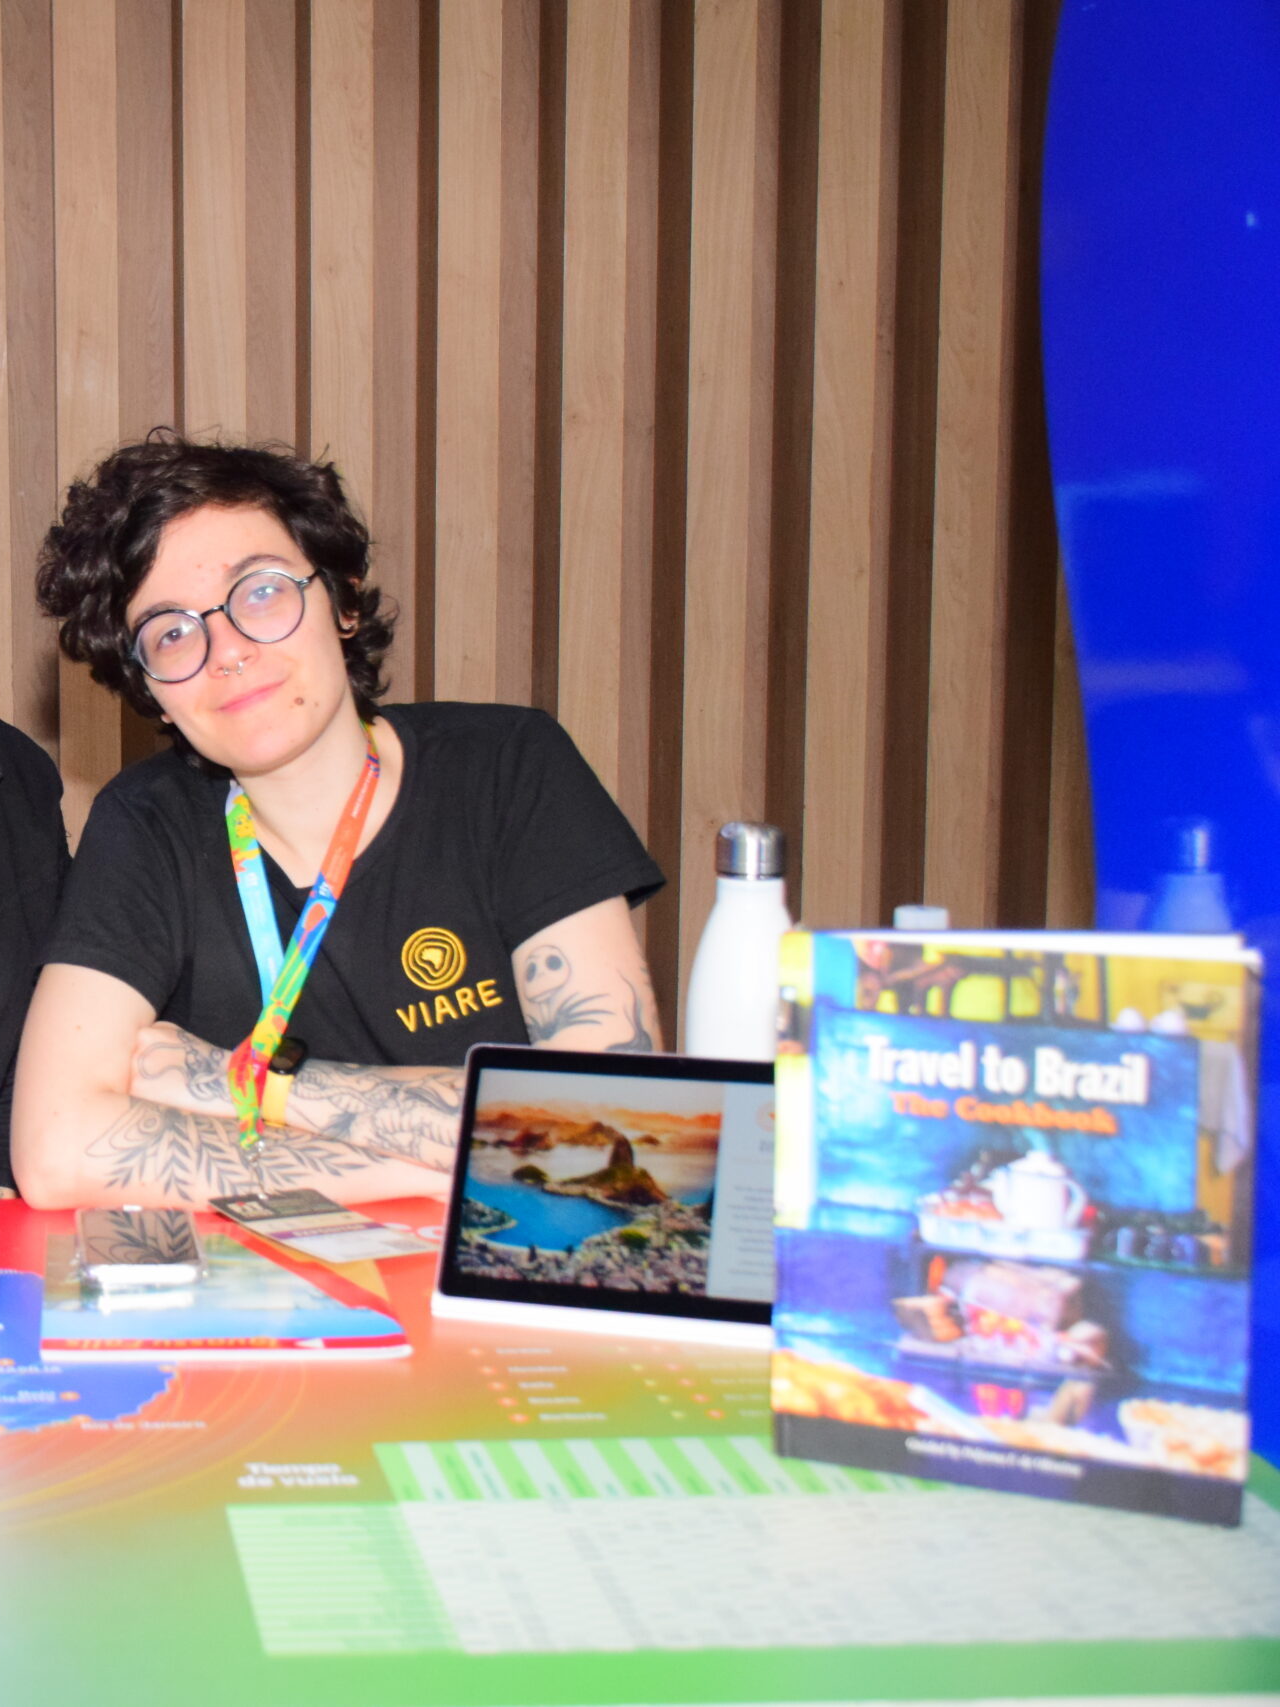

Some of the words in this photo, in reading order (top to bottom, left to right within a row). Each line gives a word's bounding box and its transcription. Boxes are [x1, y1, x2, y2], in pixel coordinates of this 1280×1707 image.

[396, 979, 503, 1033] VIARE
[863, 1034, 976, 1090] Travel
[981, 1043, 1027, 1094] to
[1034, 1046, 1150, 1105] Brazil
[889, 1091, 950, 1120] The
[954, 1096, 1118, 1135] Cookbook
[244, 1462, 343, 1480] Tiempo
[278, 1474, 361, 1487] vuelo
